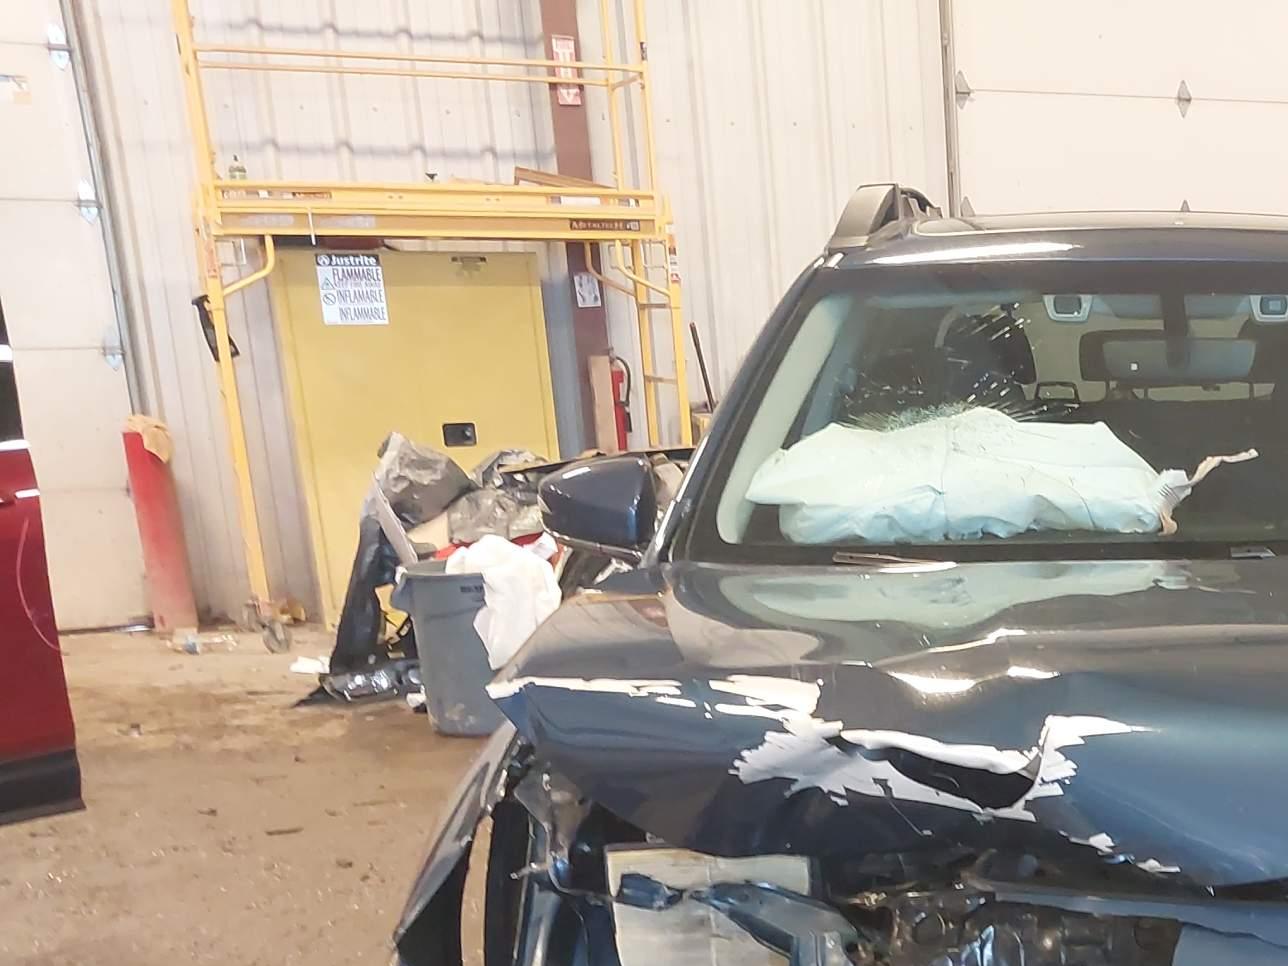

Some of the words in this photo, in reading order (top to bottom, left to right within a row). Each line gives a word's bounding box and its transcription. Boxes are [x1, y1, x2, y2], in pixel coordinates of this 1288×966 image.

[331, 255, 377, 266] Justrite
[332, 268, 381, 281] FLAMMABLE
[337, 290, 384, 303] INFLAMABLE
[339, 307, 386, 320] INFLAMMABLE
